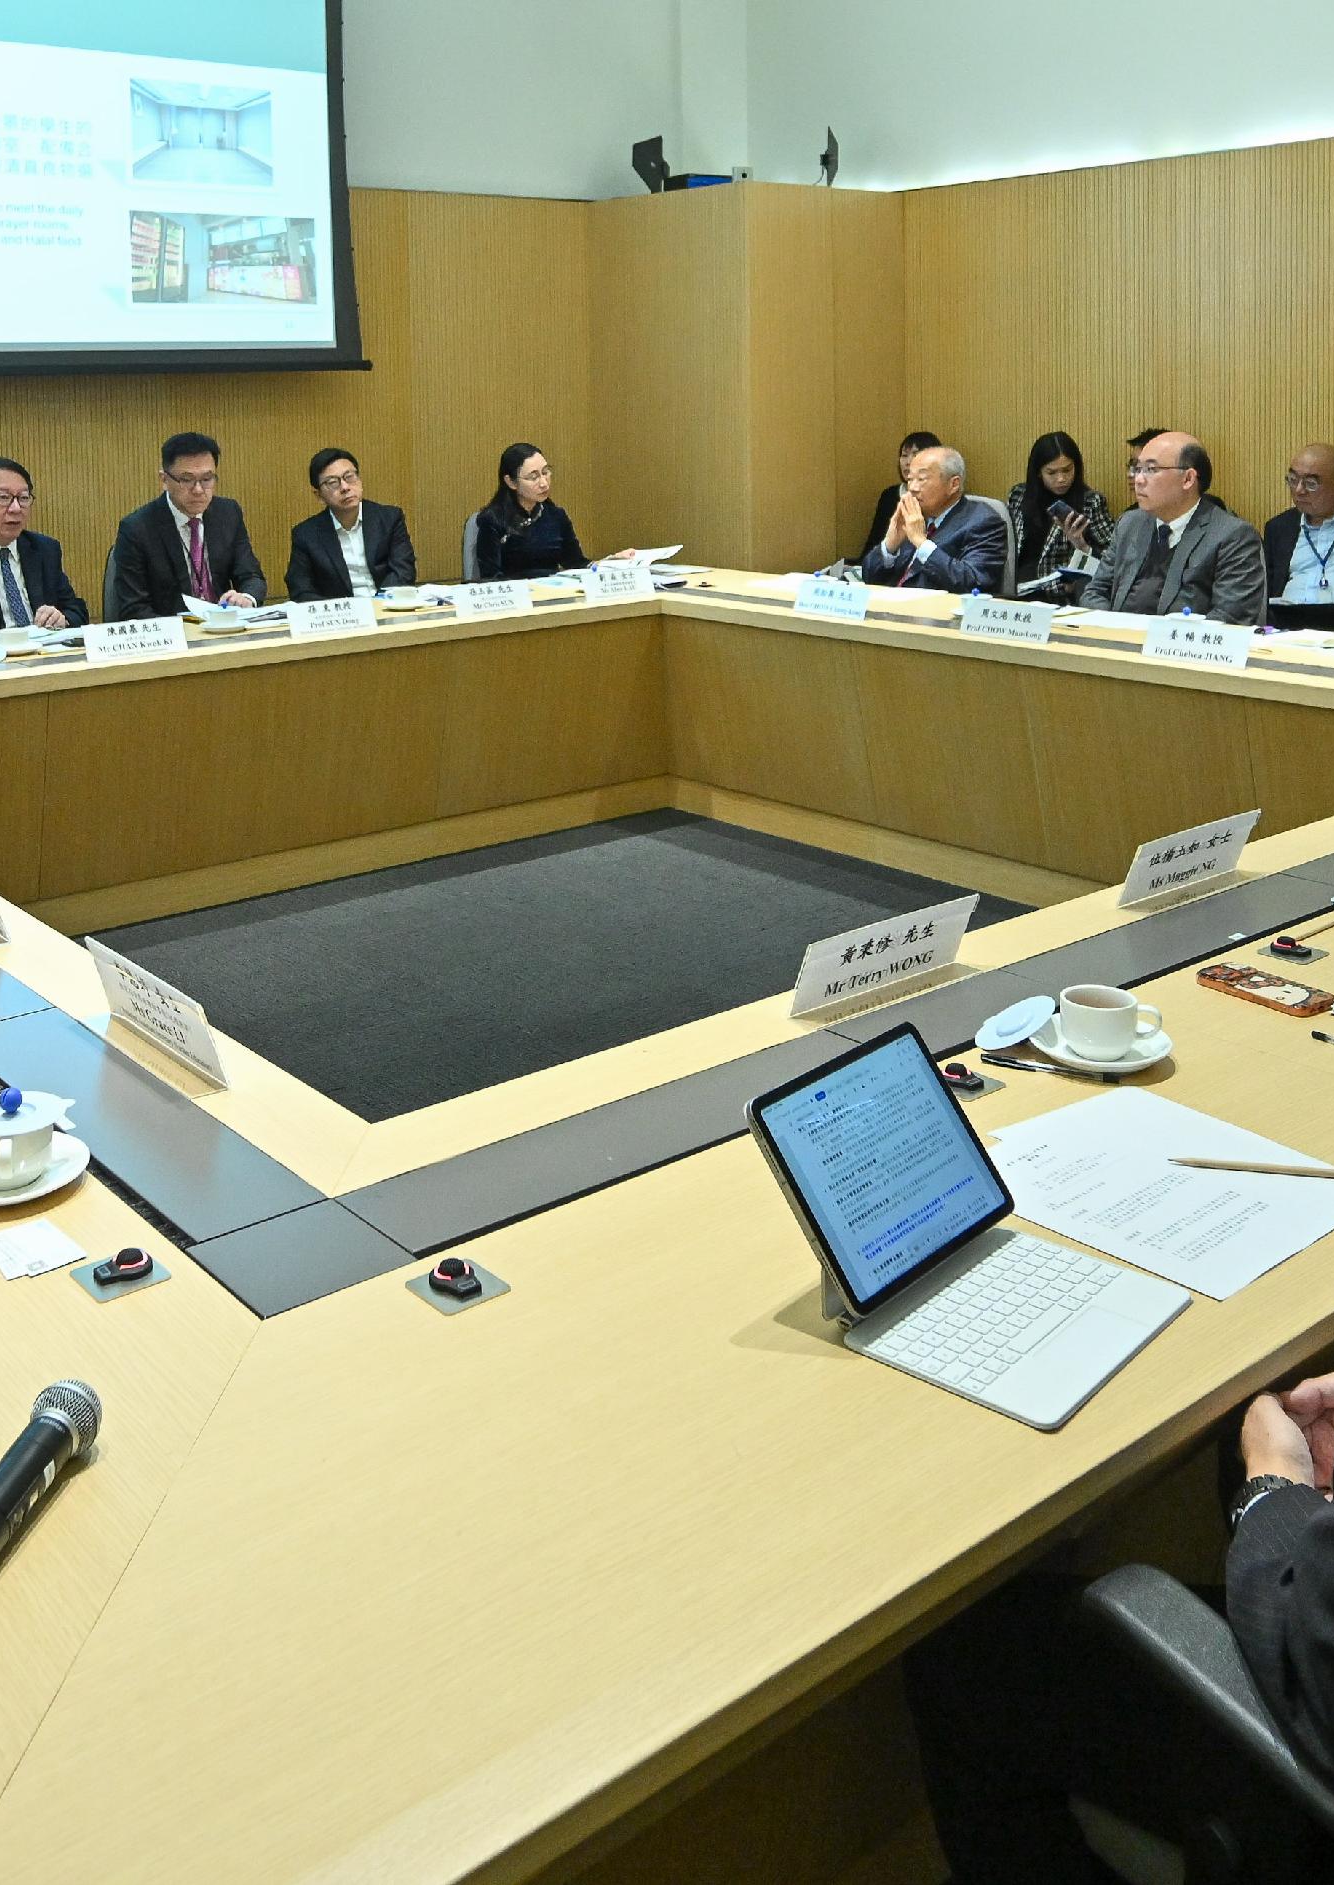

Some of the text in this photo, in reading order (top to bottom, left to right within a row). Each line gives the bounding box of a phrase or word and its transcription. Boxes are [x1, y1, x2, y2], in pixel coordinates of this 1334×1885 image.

[6, 203, 34, 214] meet
[37, 203, 56, 214] the
[1, 233, 24, 245] and
[141, 621, 162, 633] 先生
[112, 641, 137, 652] CHAN
[1154, 645, 1171, 656] Prof
[1207, 829, 1232, 849] 女士
[1148, 878, 1164, 891] Ms
[1202, 858, 1218, 870] NG
[902, 920, 937, 945] 先生
[824, 950, 934, 998] Mr Terry WONG
